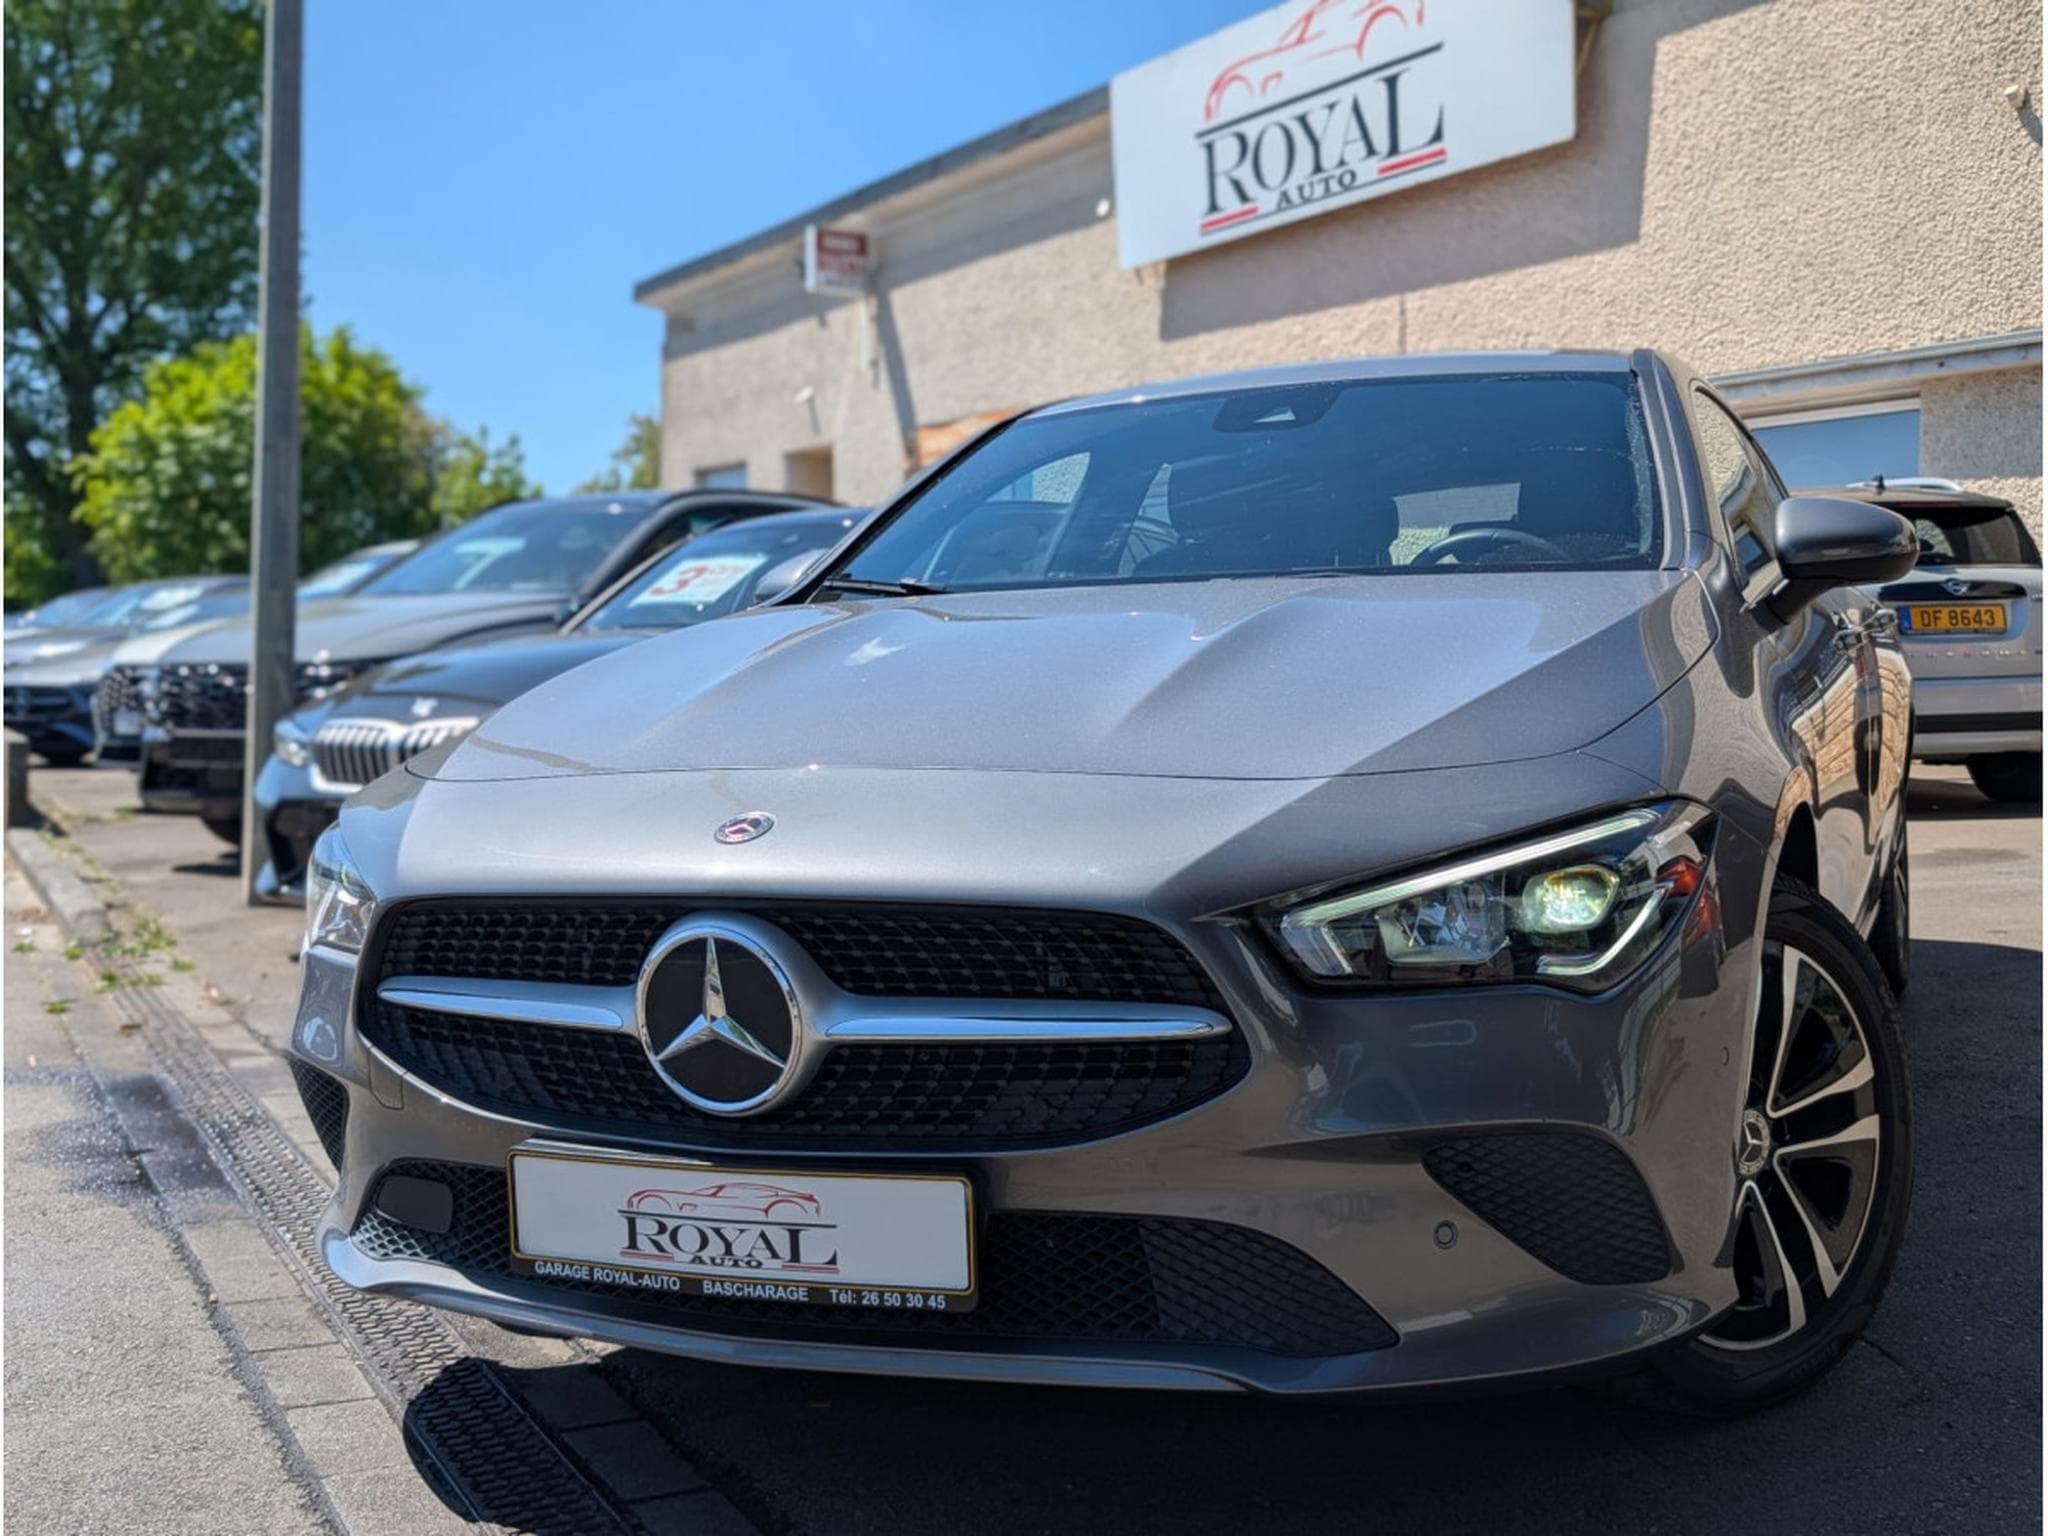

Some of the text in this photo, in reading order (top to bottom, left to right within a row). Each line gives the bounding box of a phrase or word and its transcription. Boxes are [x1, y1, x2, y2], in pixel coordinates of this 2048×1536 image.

[1201, 67, 1445, 216] ROYAL
[1274, 169, 1357, 211] AUTO
[1920, 609, 1996, 627] DF 8643
[620, 1214, 838, 1266] ROYAL
[689, 1255, 763, 1269] AUTO
[534, 1260, 947, 1310] GARAGE ROYAL-AUTO BASCHARAGE Tél: 26 50 30 45
